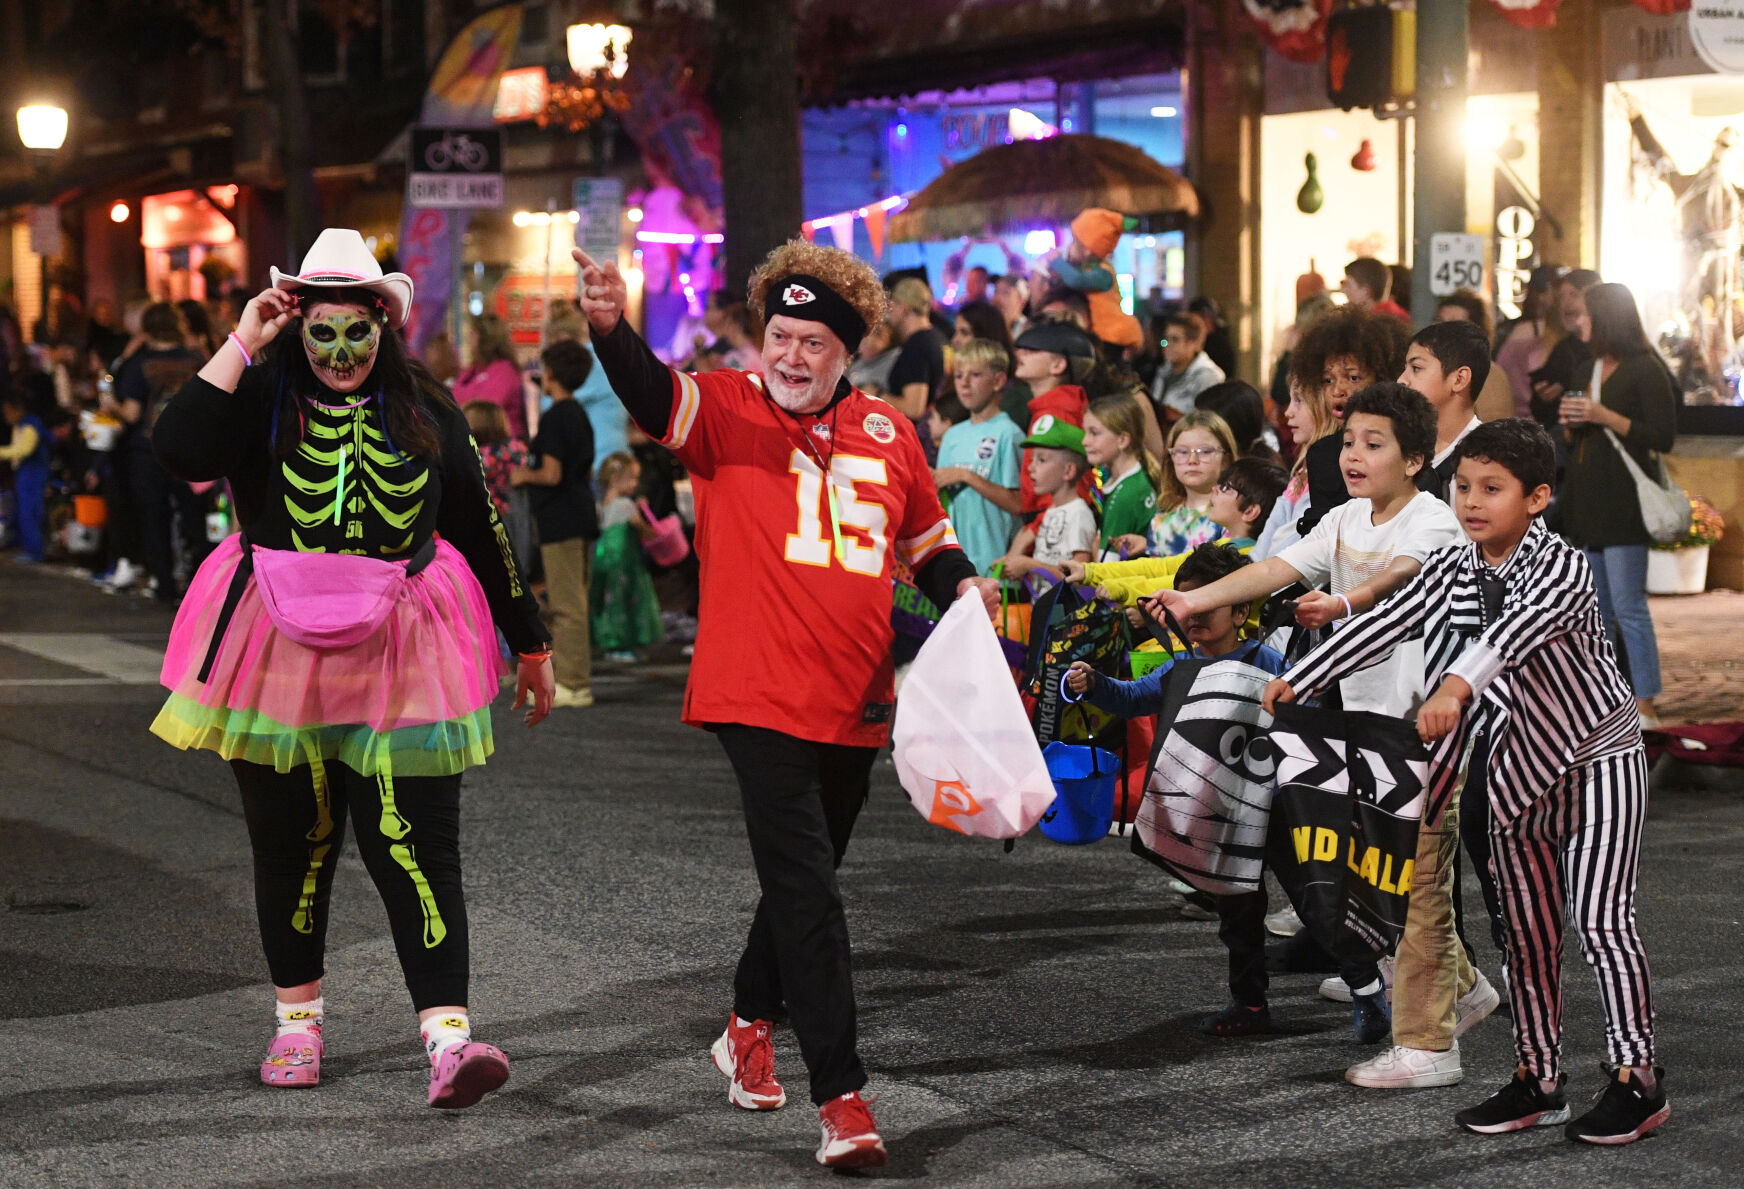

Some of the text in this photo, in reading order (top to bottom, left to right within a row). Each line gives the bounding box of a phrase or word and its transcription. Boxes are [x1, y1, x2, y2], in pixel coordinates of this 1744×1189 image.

[1697, 8, 1734, 19] URBAN
[411, 181, 498, 200] BIKE LANE
[1436, 260, 1483, 288] 450
[789, 289, 808, 303] KC
[784, 447, 888, 578] 15
[1039, 666, 1060, 743] POKÉMON
